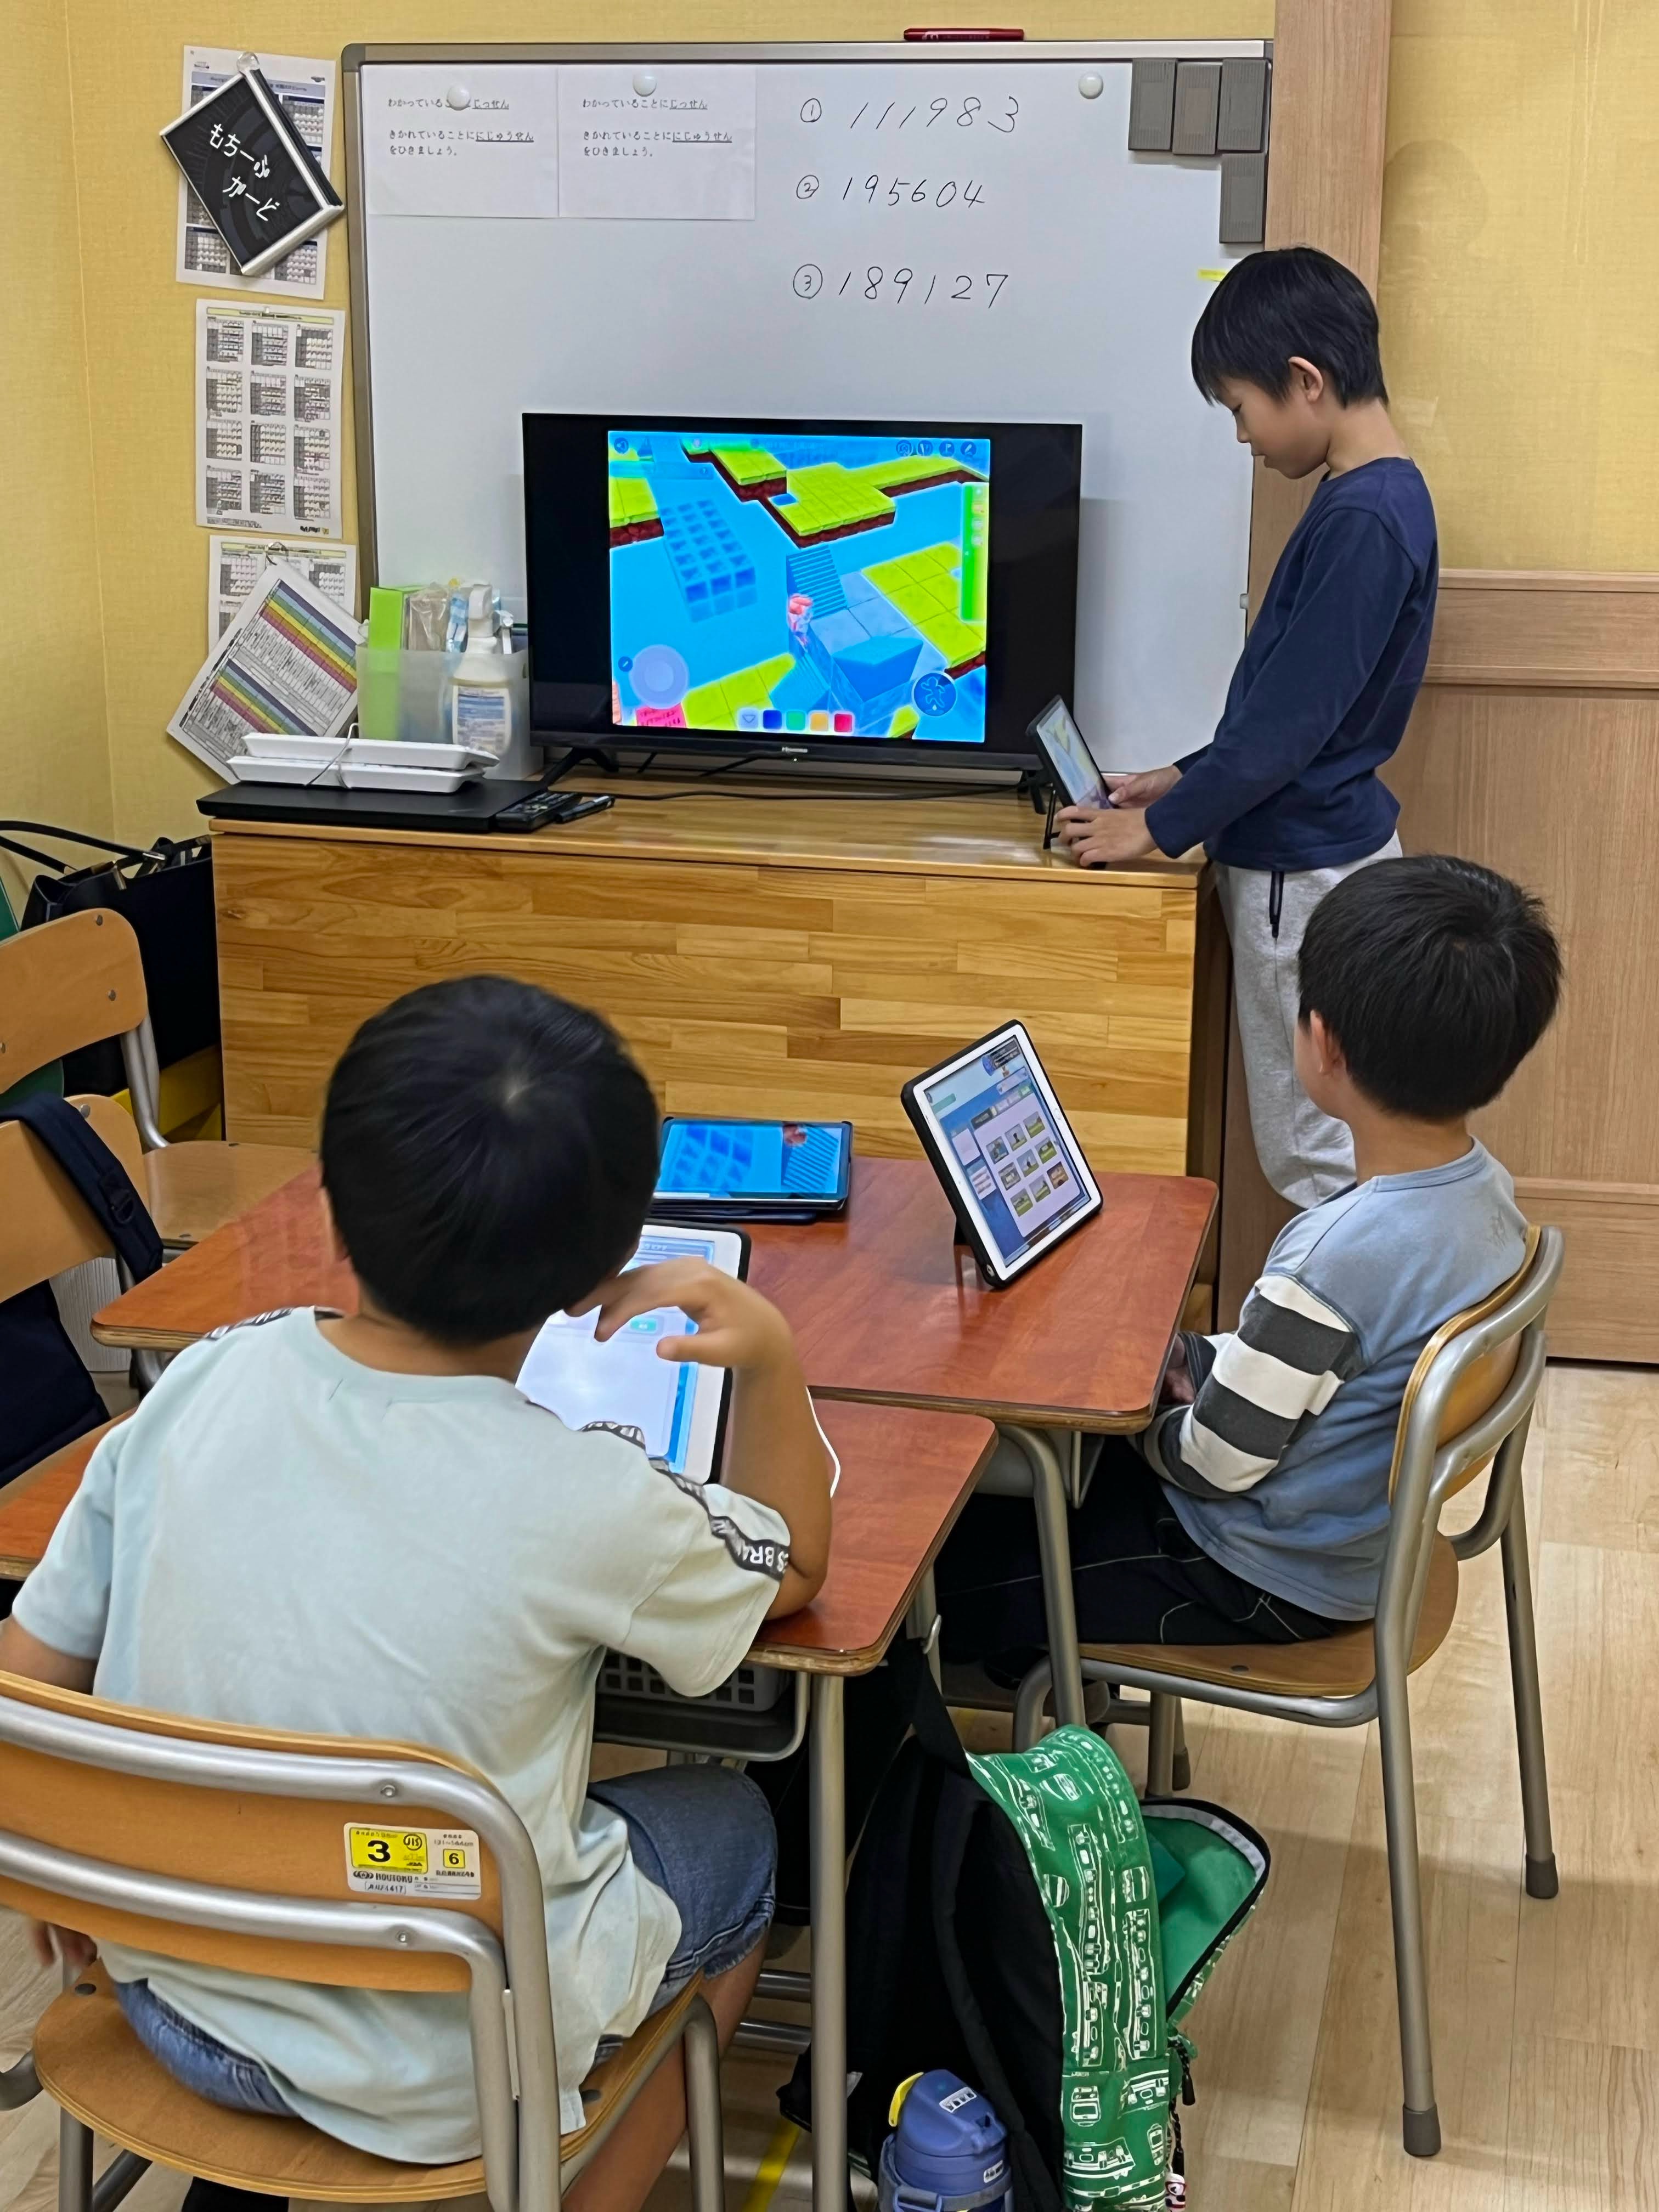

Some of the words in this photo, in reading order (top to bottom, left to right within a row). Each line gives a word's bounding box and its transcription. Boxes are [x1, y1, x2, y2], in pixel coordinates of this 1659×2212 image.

[850, 96, 1019, 133] 111983
[843, 174, 985, 208] 195604
[839, 266, 1009, 308] 189127
[368, 1840, 391, 1863] 3
[449, 1853, 460, 1865] 6
